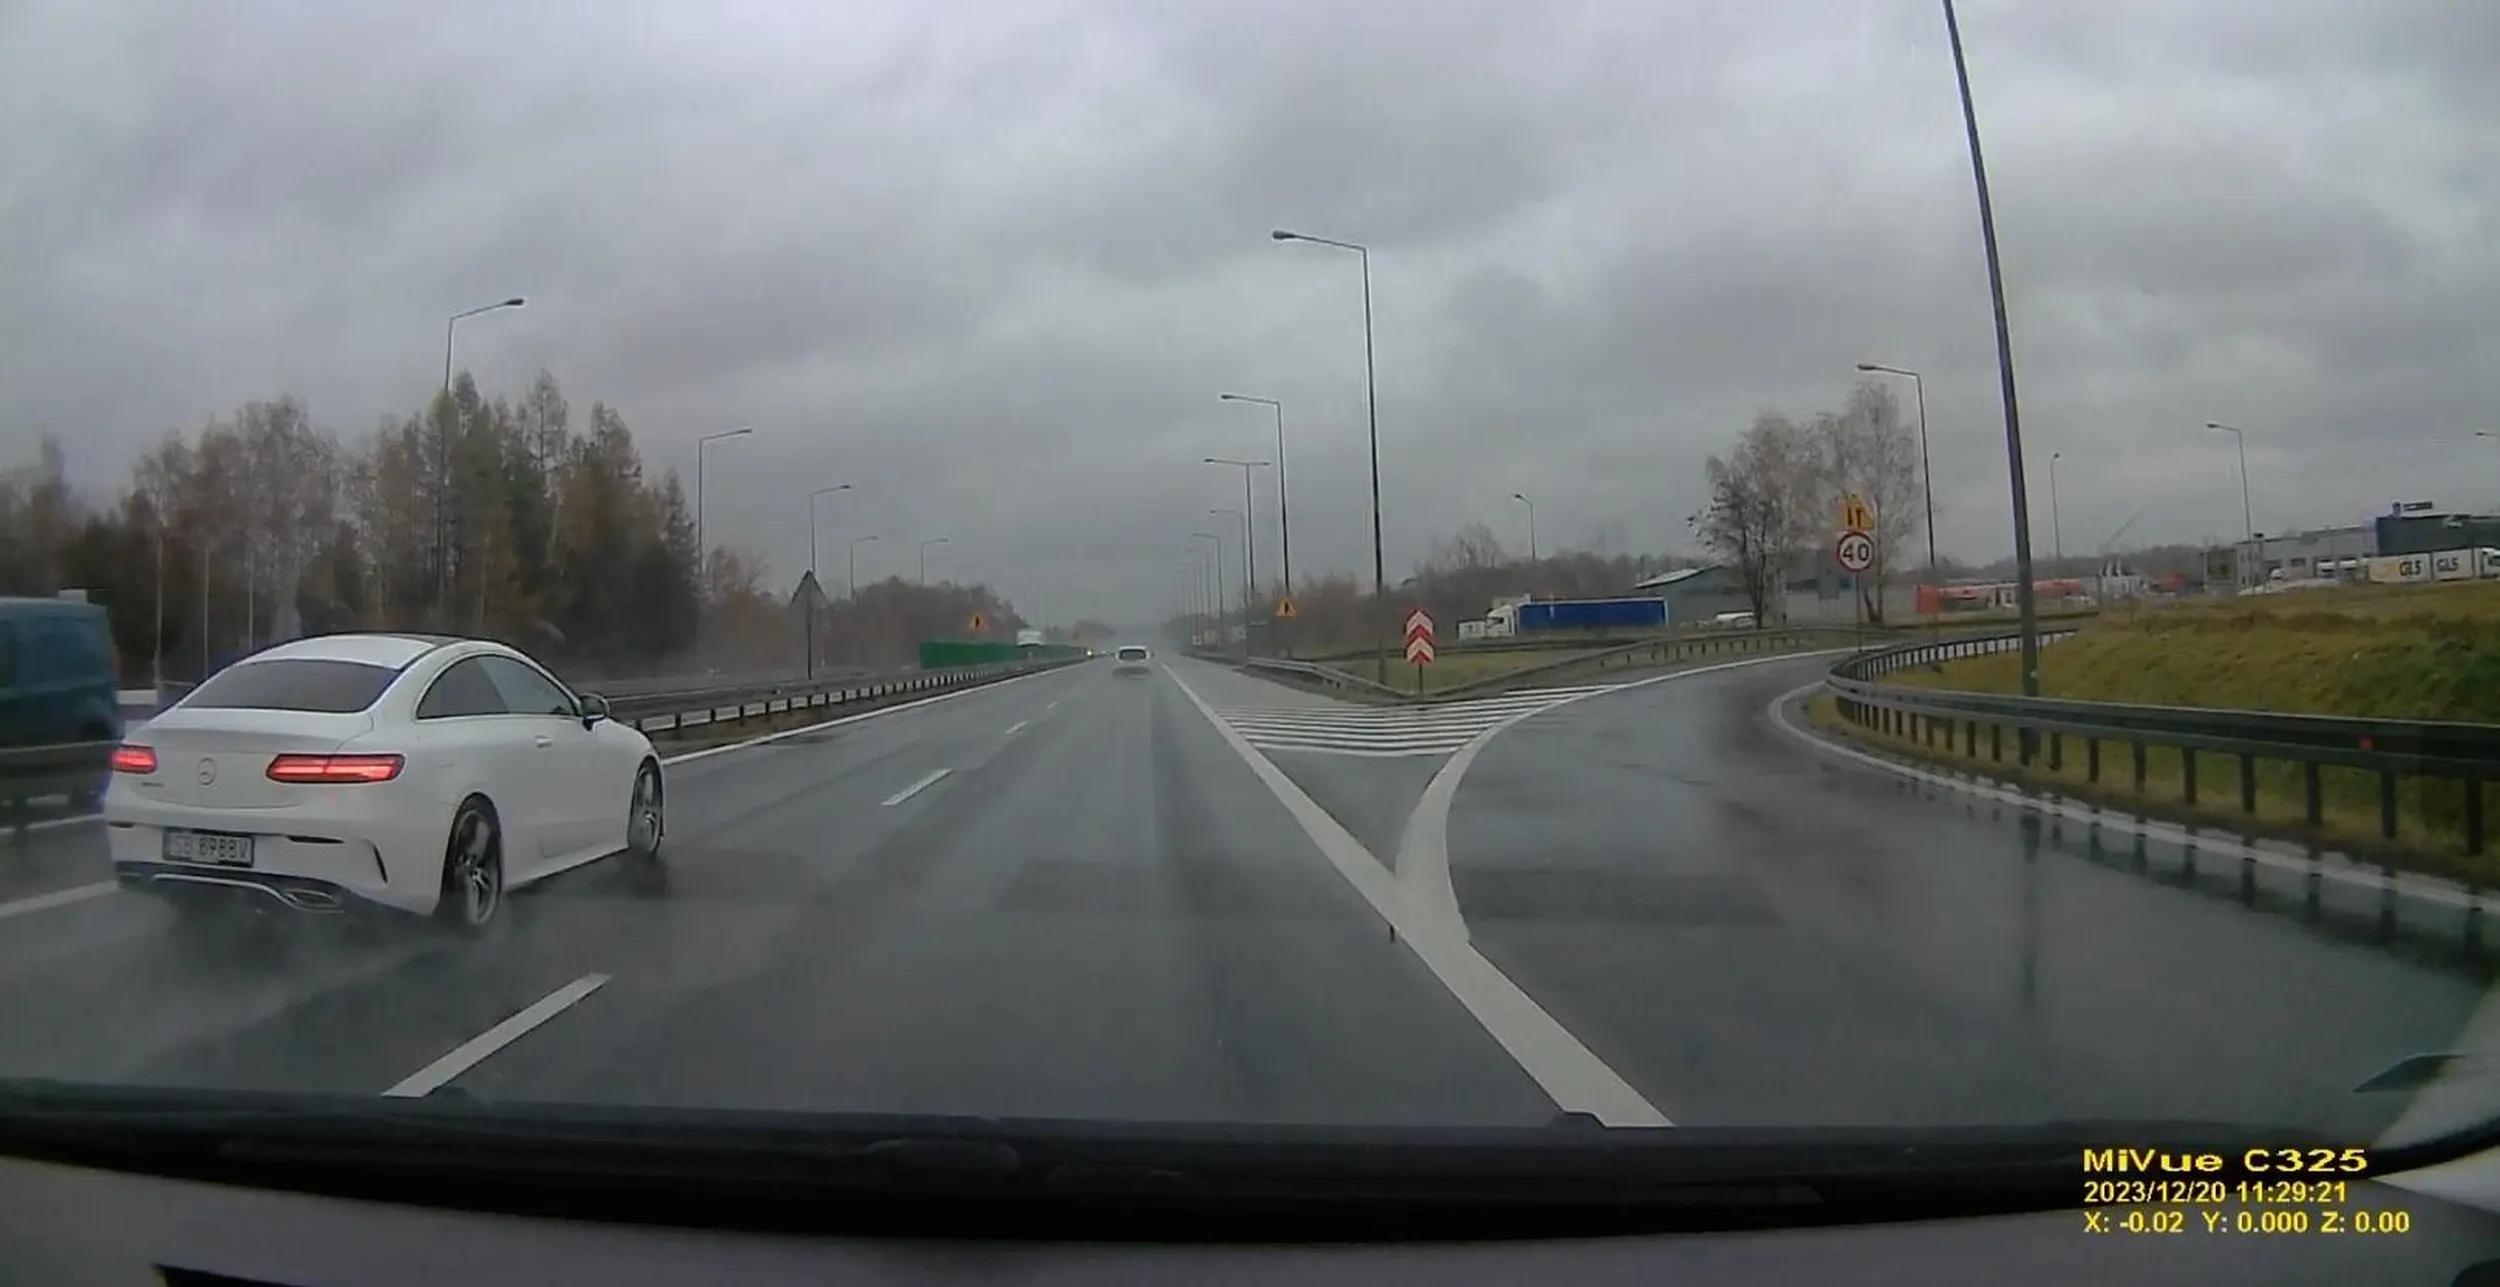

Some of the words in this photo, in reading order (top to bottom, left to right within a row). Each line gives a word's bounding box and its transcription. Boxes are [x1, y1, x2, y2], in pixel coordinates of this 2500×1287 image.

[1842, 543, 1869, 562] 40
[2399, 560, 2421, 576] GLS
[2437, 558, 2458, 572] GLS
